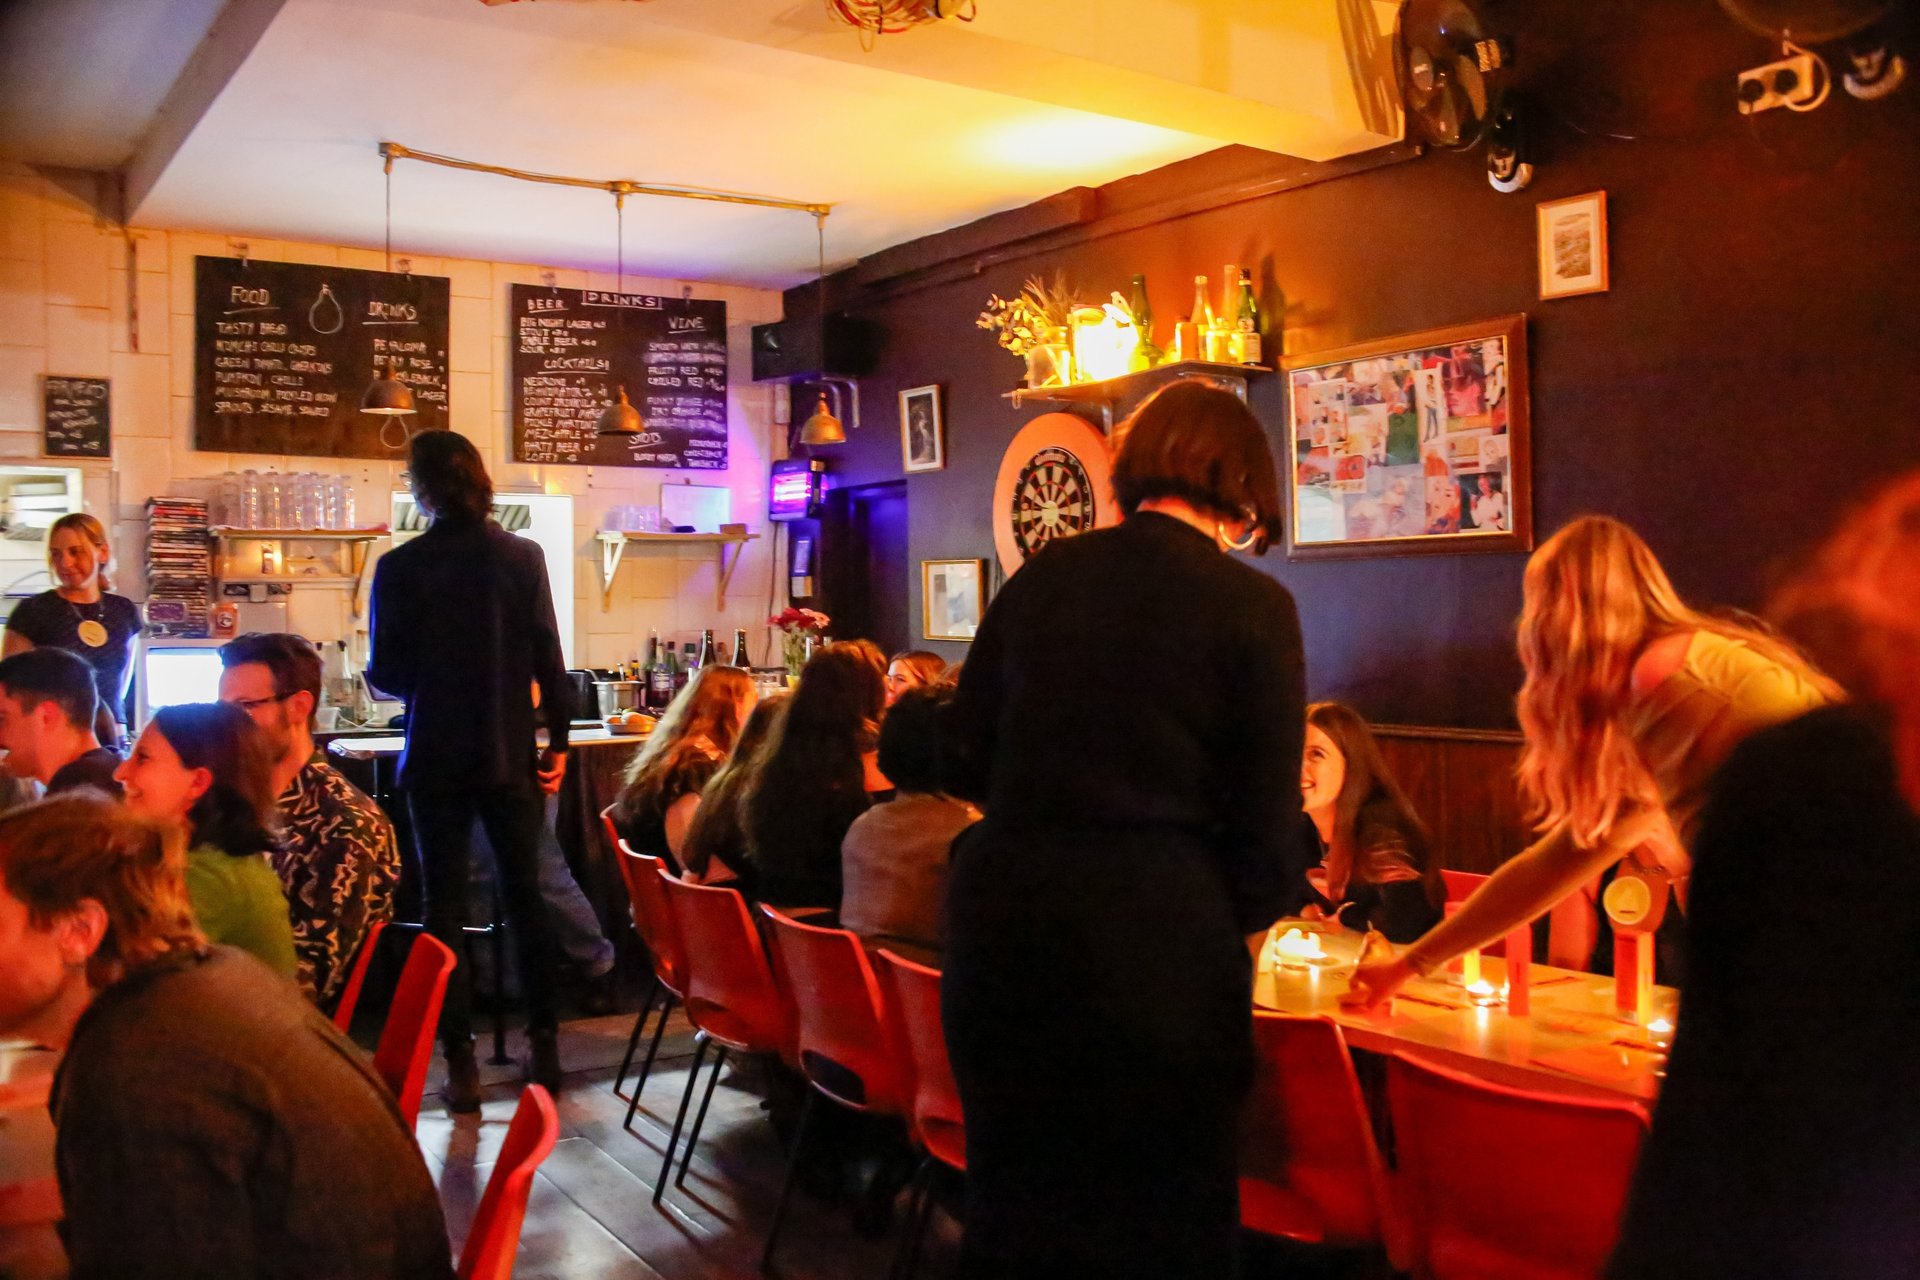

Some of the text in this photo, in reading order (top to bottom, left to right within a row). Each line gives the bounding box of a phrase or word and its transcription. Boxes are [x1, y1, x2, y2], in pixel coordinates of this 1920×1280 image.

[231, 286, 270, 306] FOOD
[588, 292, 656, 307] DRINKS
[527, 299, 564, 310] BEER
[368, 301, 417, 320] DRINKS
[216, 321, 254, 335] TASTY
[566, 320, 593, 330] LAGER
[519, 328, 550, 337] STOUT
[554, 337, 578, 346] BEER
[519, 345, 545, 354] SOUR
[680, 366, 699, 375] RED
[688, 377, 703, 388] RED
[523, 417, 553, 428] PICKLE
[555, 442, 580, 453] BEER
